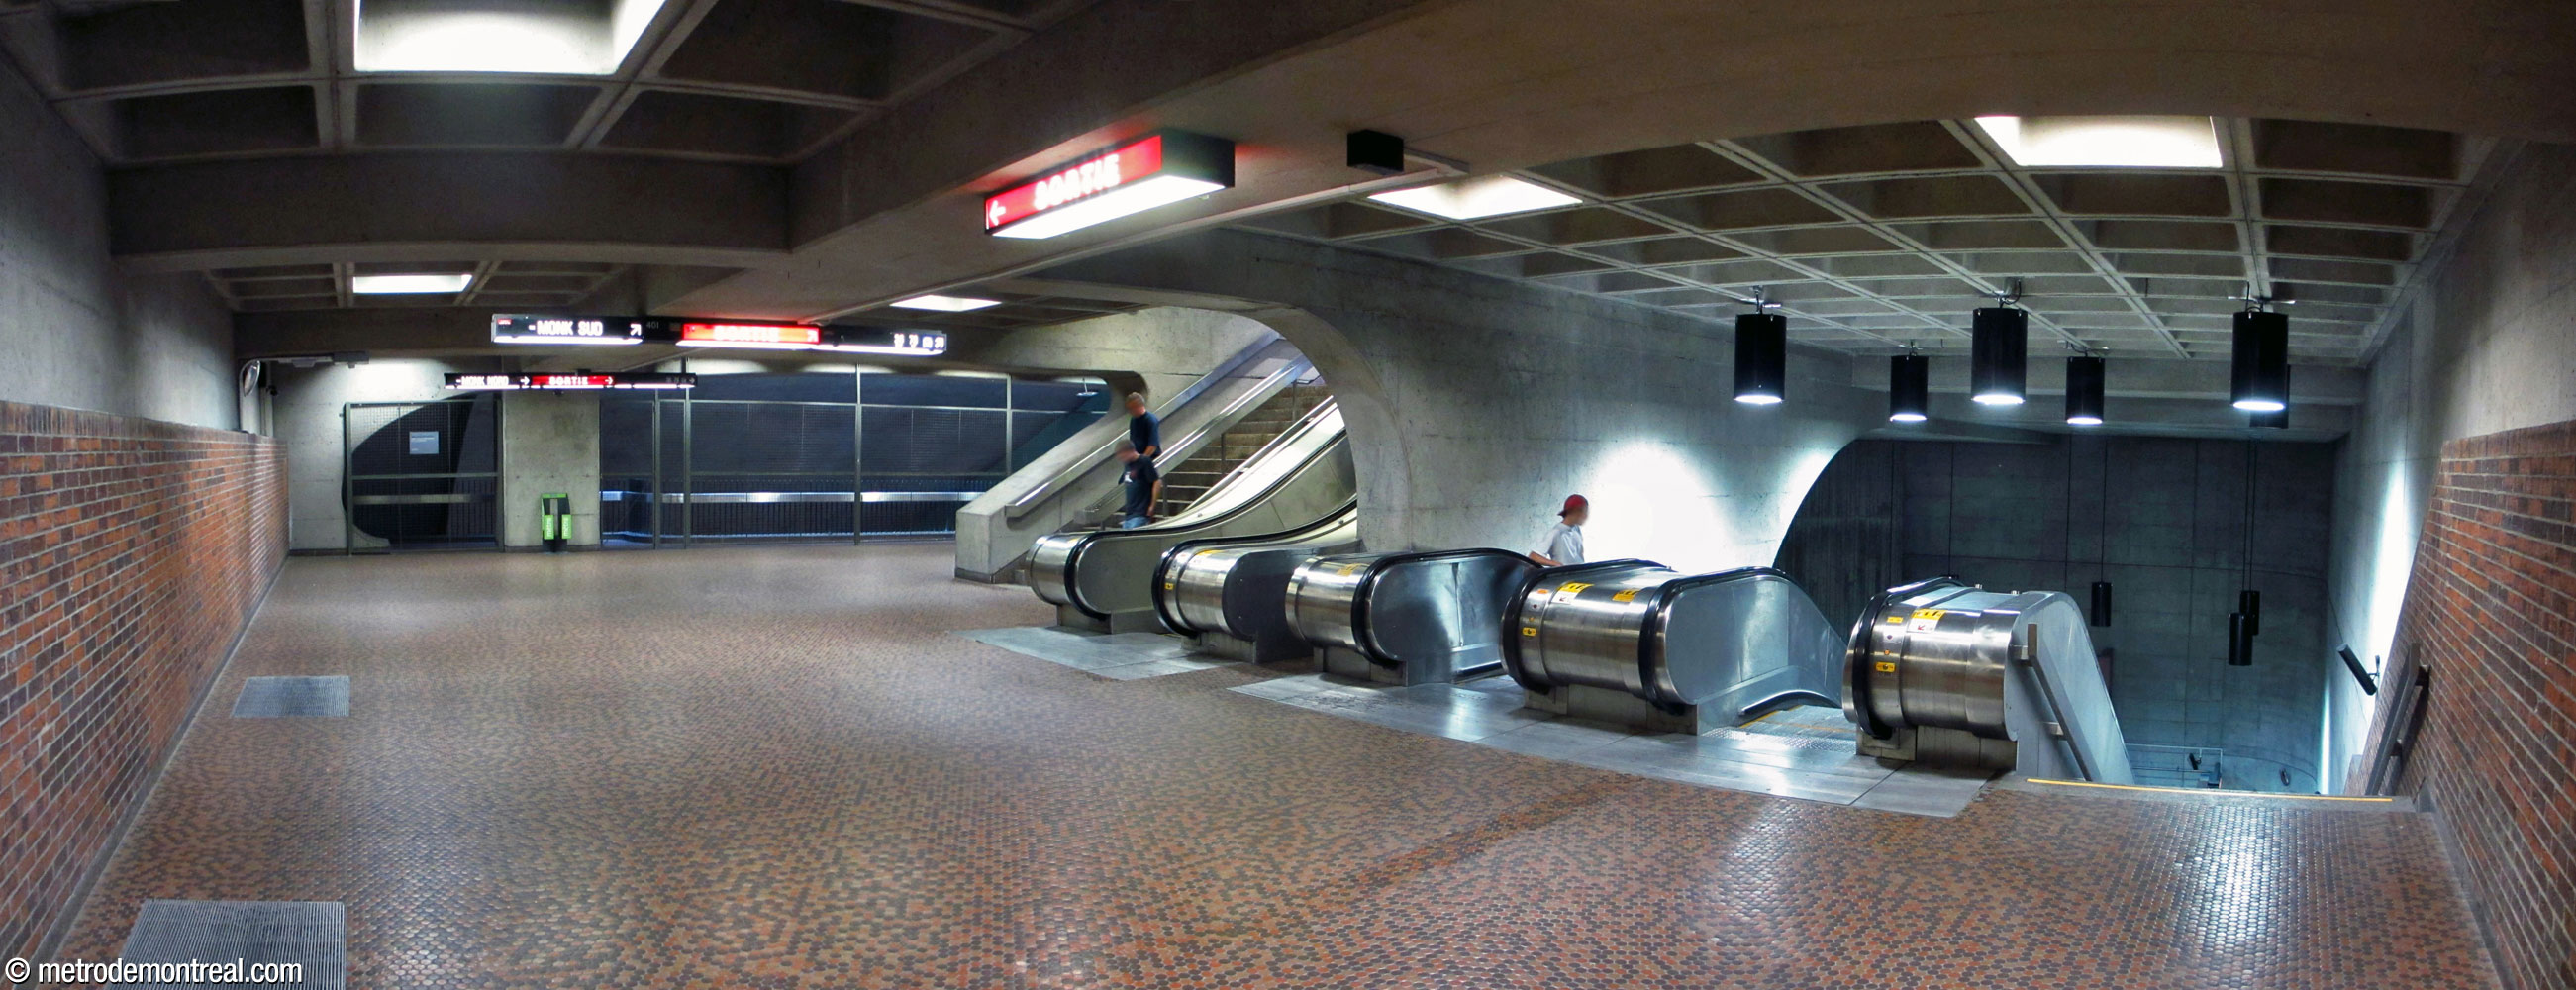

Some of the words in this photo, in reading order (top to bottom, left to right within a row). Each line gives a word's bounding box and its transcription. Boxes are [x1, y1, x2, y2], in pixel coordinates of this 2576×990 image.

[1034, 153, 1120, 210] SORTIE
[578, 321, 604, 337] SUD
[548, 376, 589, 386] SORTIE
